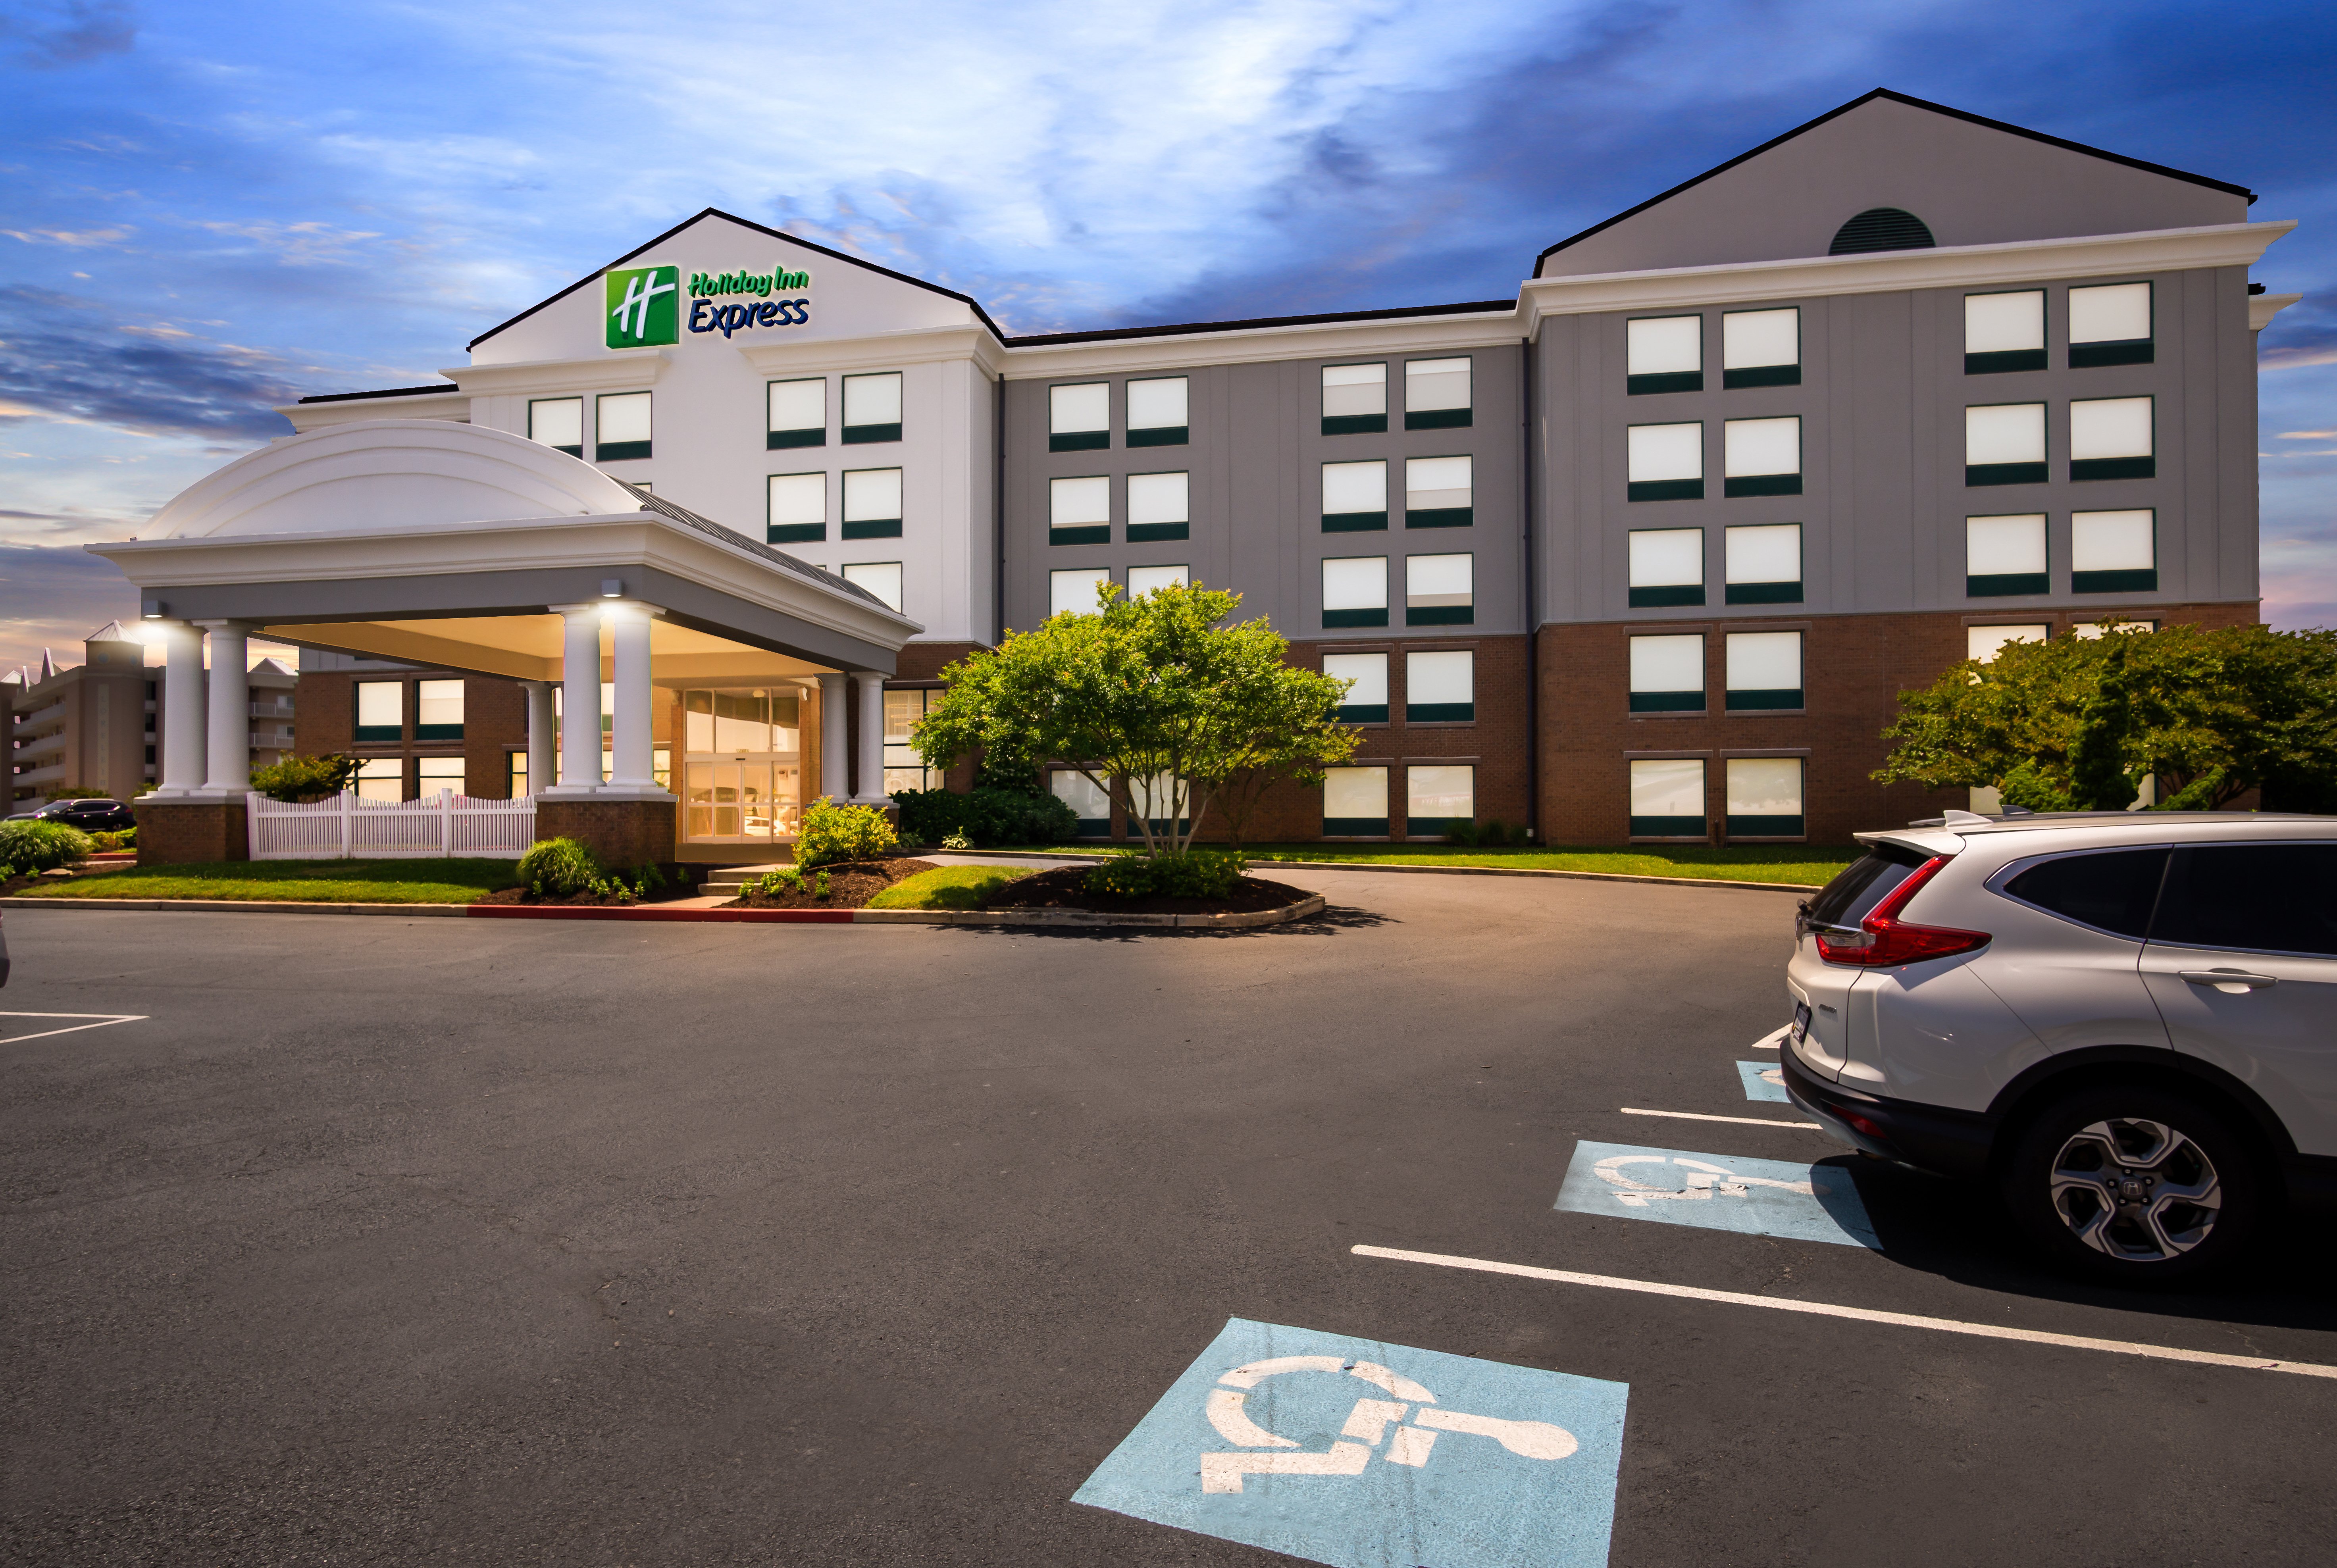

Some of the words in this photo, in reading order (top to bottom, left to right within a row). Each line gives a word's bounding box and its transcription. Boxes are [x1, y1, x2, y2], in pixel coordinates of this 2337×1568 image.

[687, 270, 773, 298] Holiday
[774, 266, 809, 291] Inn
[688, 298, 809, 339] Express
